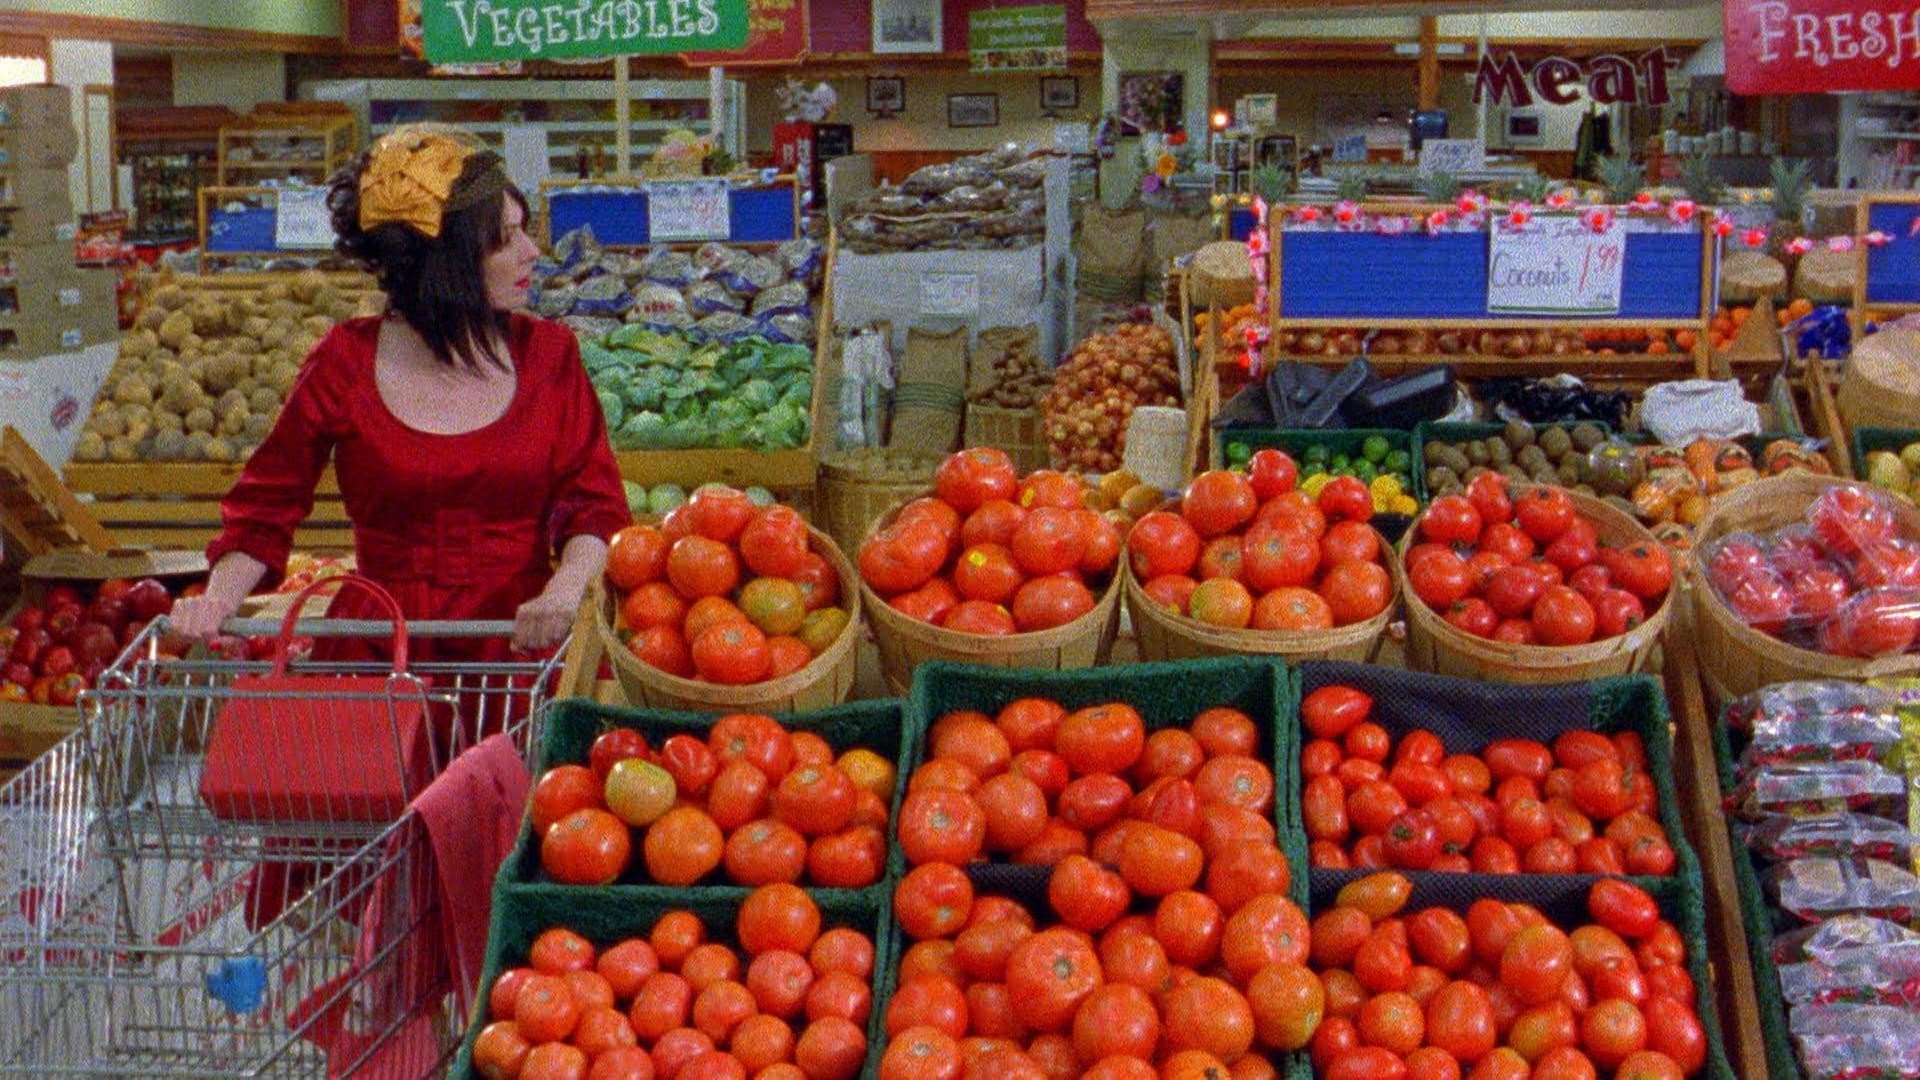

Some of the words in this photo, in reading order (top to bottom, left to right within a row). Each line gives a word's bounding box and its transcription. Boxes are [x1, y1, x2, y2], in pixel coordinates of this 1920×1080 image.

[446, 0, 719, 53] VEGETABLES
[1750, 2, 1920, 67] FRESH
[1472, 45, 1680, 107] Meat
[1490, 251, 1570, 288] Coconuts
